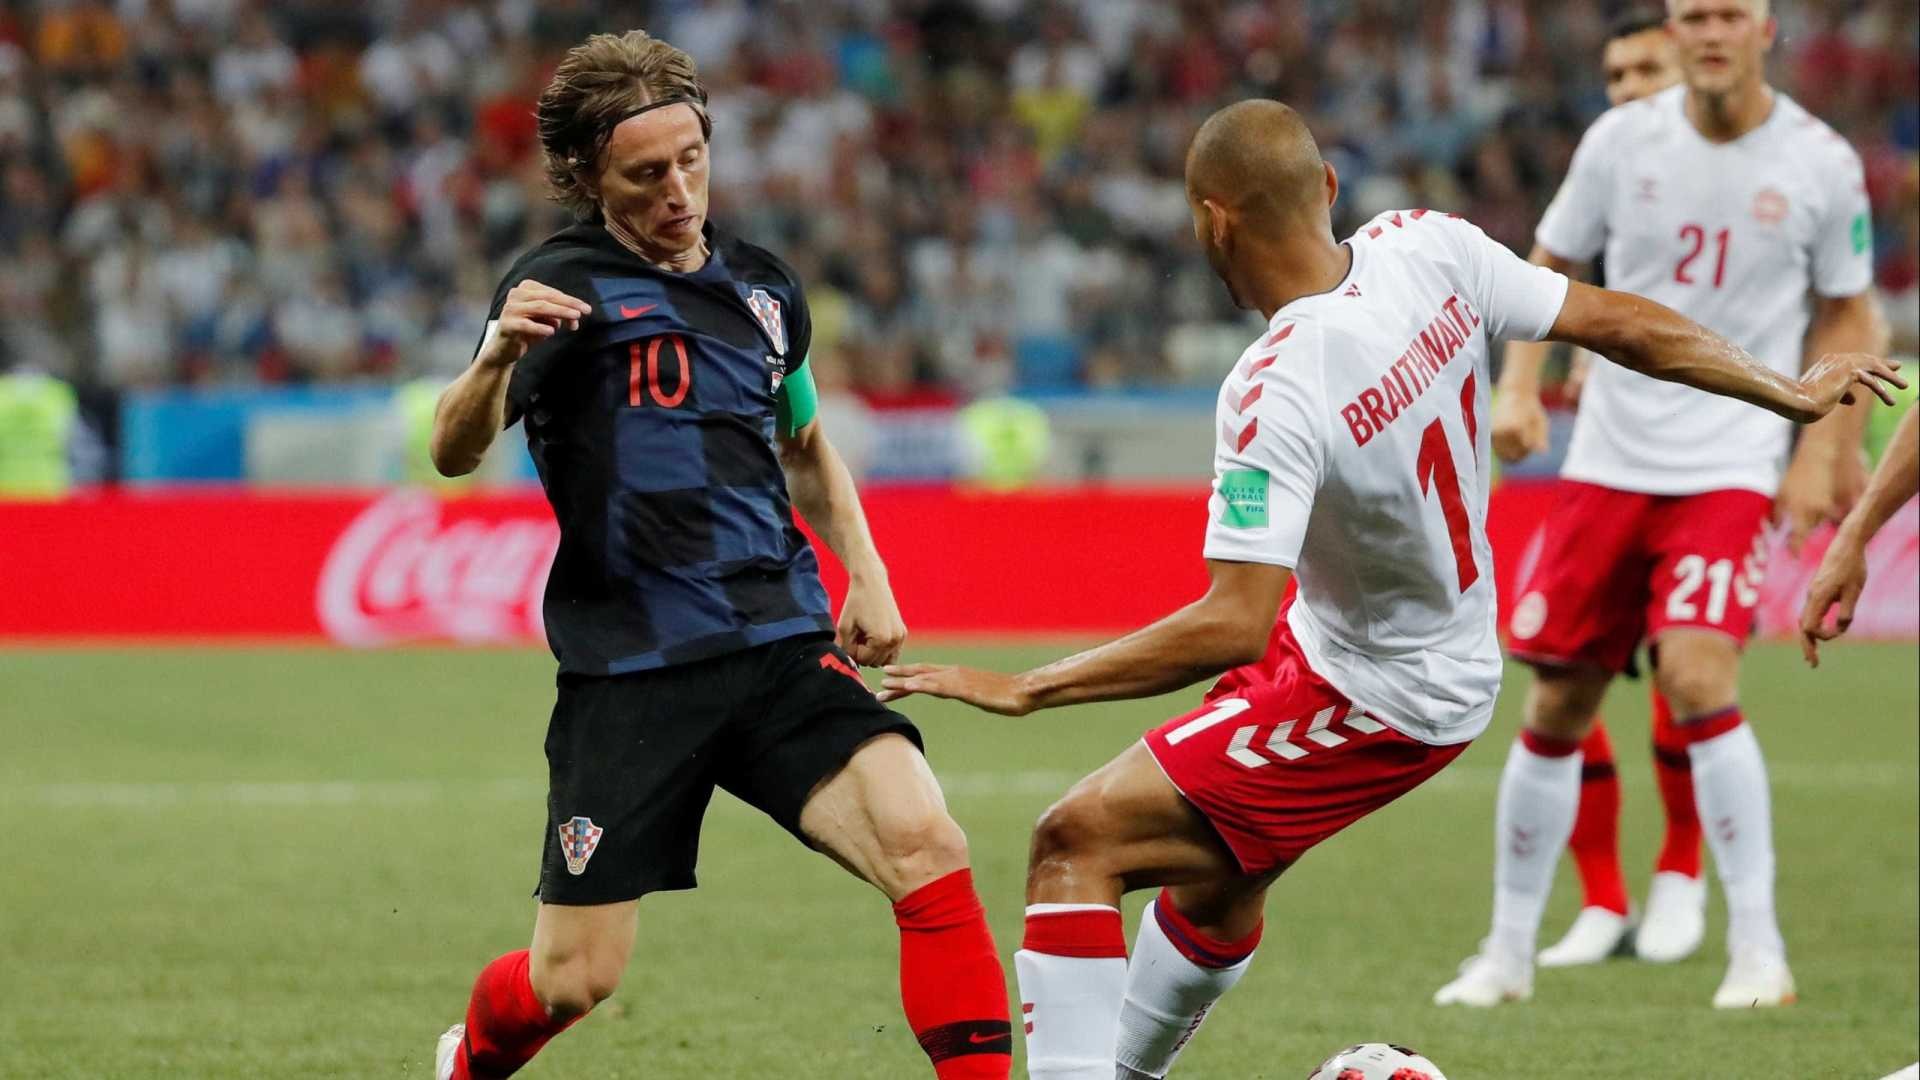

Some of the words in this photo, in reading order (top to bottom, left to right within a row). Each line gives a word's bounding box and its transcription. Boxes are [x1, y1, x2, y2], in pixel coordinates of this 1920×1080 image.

[1673, 223, 1731, 289] 21
[629, 333, 691, 409] 10
[1665, 554, 1735, 624] 21
